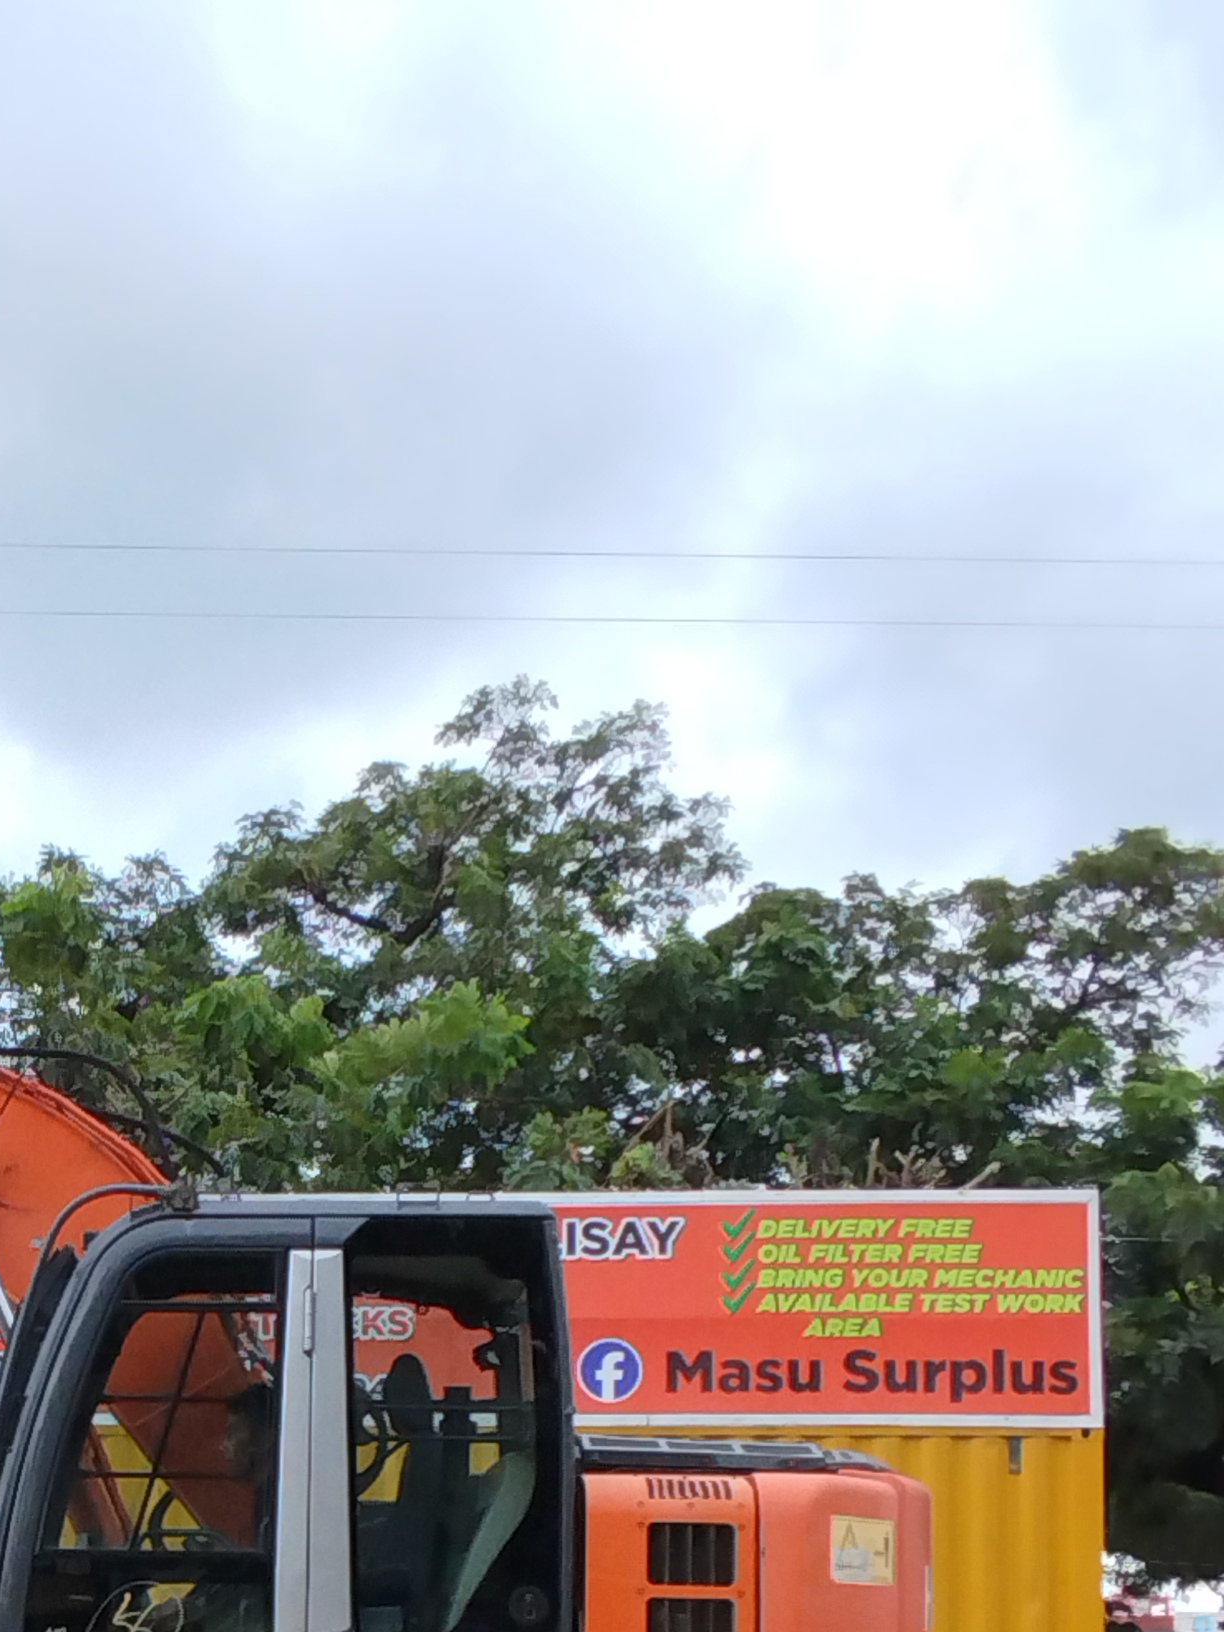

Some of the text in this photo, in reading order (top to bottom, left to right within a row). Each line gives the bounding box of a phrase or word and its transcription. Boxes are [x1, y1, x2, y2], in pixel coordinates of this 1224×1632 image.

[757, 1219, 973, 1238] DELIVERY FREE
[559, 1218, 685, 1260] ISAY
[758, 1243, 983, 1263] OIL FILTER FREE
[757, 1268, 1084, 1288] BRING YOUR MECHANIC
[755, 1293, 1085, 1313] AVAILABLE TEST WORK
[803, 1317, 882, 1337] AREA
[666, 1349, 1079, 1402] Masu Surplus
